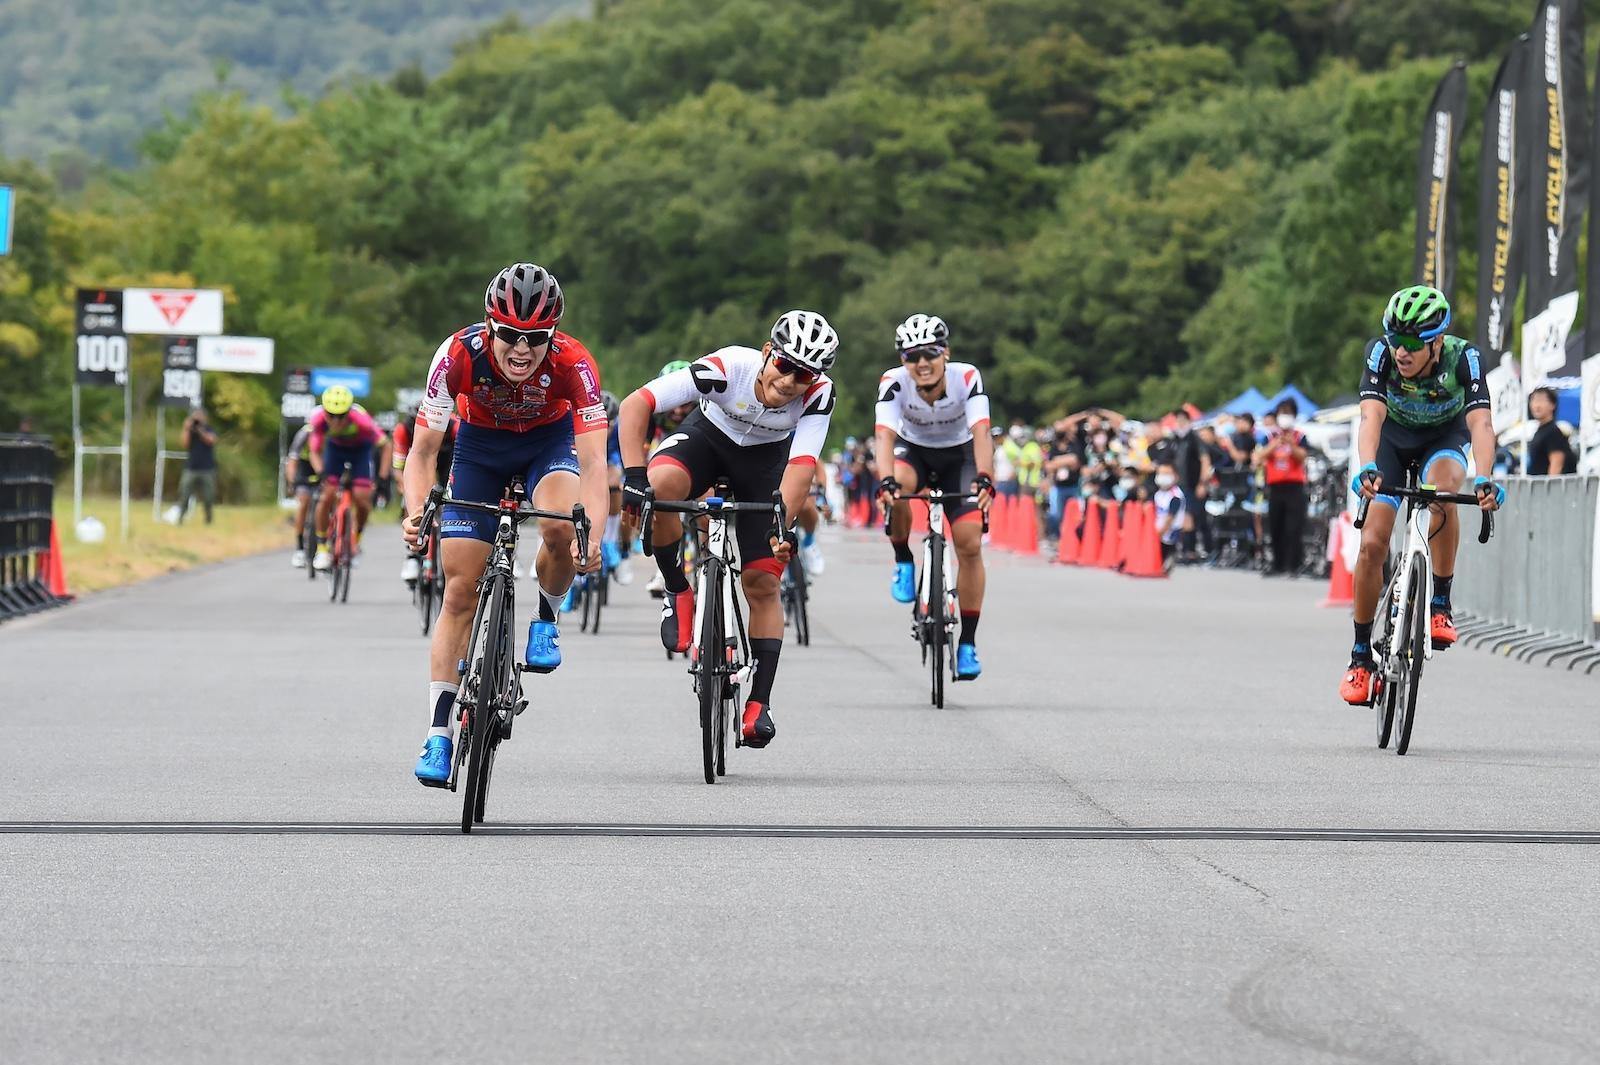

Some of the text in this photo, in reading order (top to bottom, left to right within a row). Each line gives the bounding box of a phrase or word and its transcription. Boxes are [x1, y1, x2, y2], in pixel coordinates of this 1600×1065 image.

[1545, 4, 1559, 84] SERIES
[1433, 111, 1448, 178] SERIES
[1498, 89, 1511, 163] SERIES
[1547, 87, 1561, 150] ROAD
[1497, 166, 1509, 224] ROAD
[1546, 154, 1561, 225] CYCLE
[1492, 225, 1508, 293] CYCLE
[77, 334, 128, 372] 100
[163, 369, 202, 398] 150
